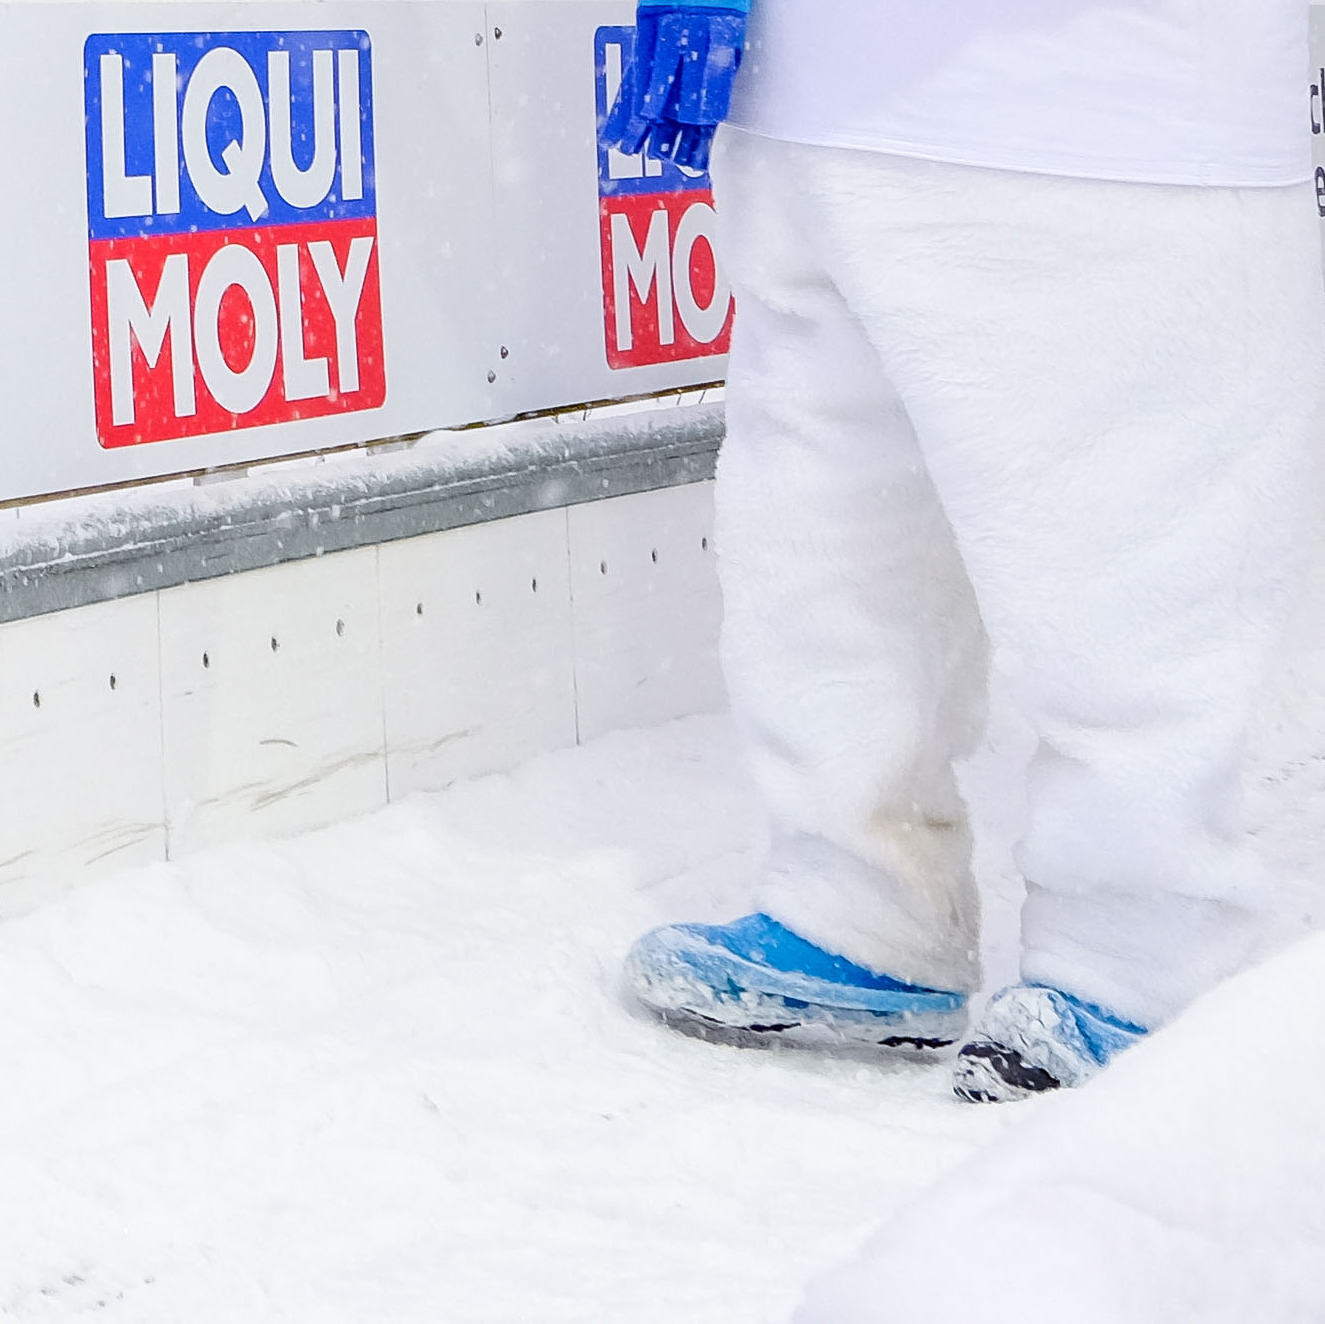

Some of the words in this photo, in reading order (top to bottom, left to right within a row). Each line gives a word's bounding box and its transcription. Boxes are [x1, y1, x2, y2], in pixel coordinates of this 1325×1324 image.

[100, 46, 364, 222] LIQUI
[105, 236, 375, 428] MOLY
[610, 202, 733, 352] MO
